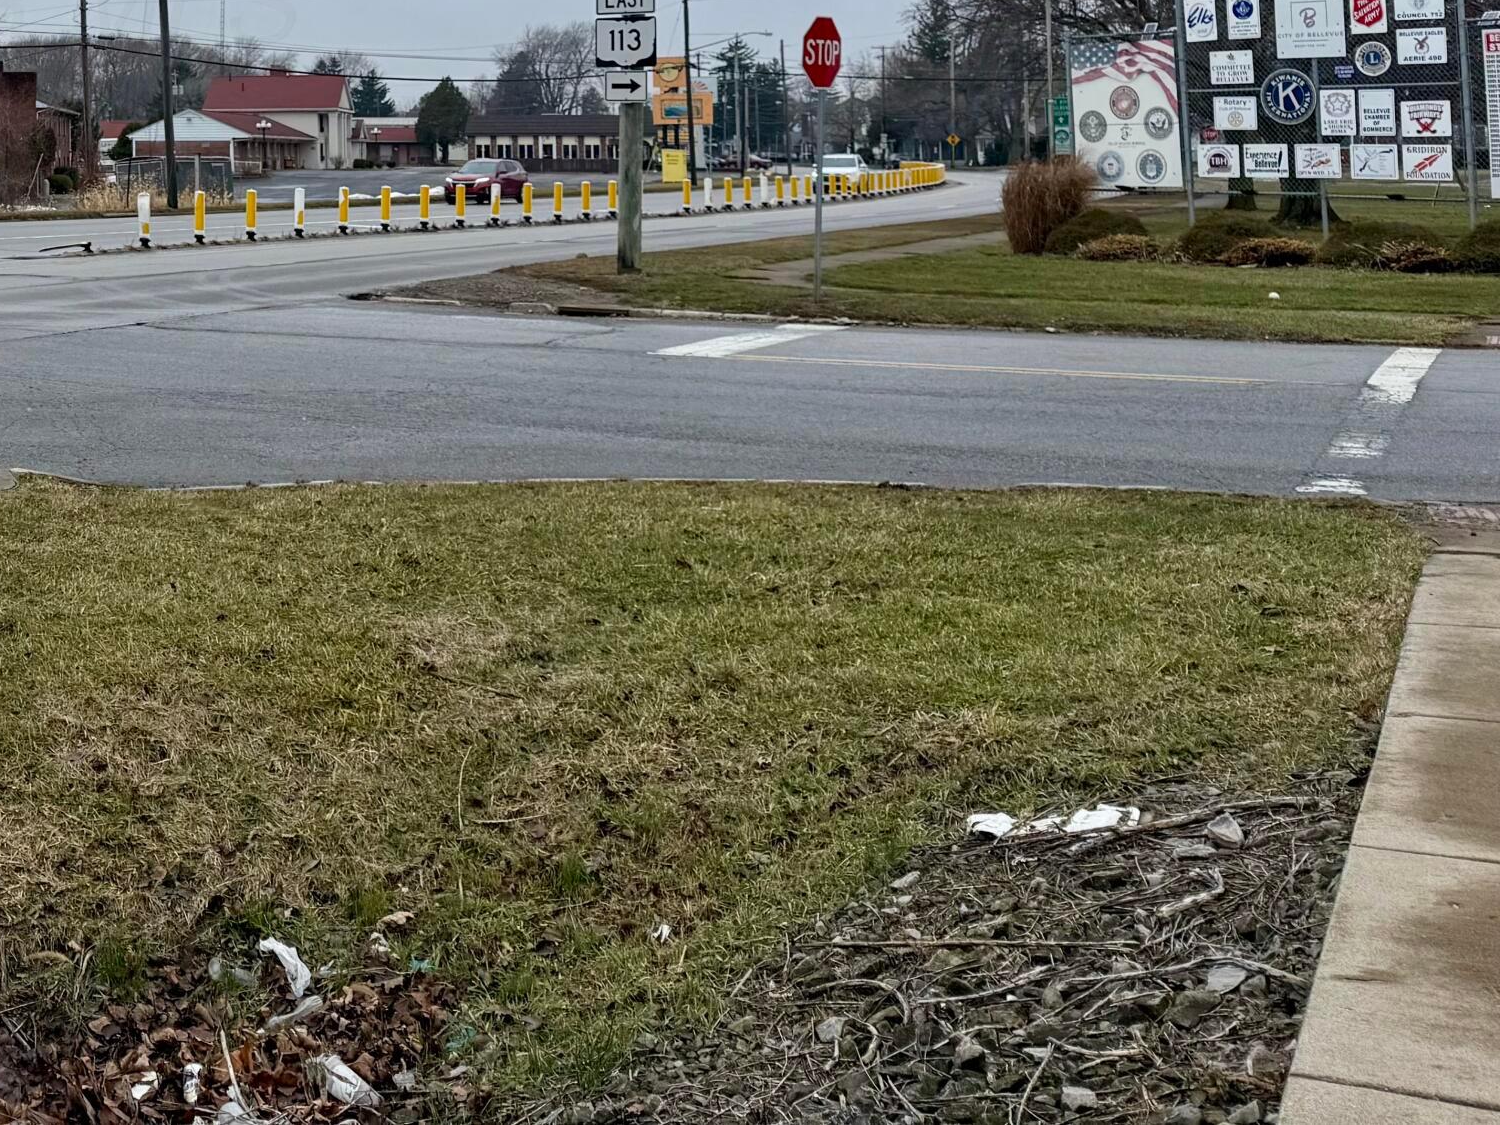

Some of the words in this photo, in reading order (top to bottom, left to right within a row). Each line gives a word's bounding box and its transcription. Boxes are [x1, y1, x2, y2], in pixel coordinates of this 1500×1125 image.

[1187, 6, 1213, 28] Elks
[1364, 7, 1380, 24] ARMY
[608, 28, 642, 52] 113
[805, 39, 839, 66] STOP
[1370, 53, 1378, 64] L
[1270, 75, 1305, 86] KIWANIS
[1278, 81, 1301, 111] K
[1266, 92, 1310, 119] INTERNATIONAL
[1245, 151, 1277, 162] Experience
[1406, 146, 1447, 154] GRIDIRON
[1406, 171, 1450, 179] FOUNDATION
